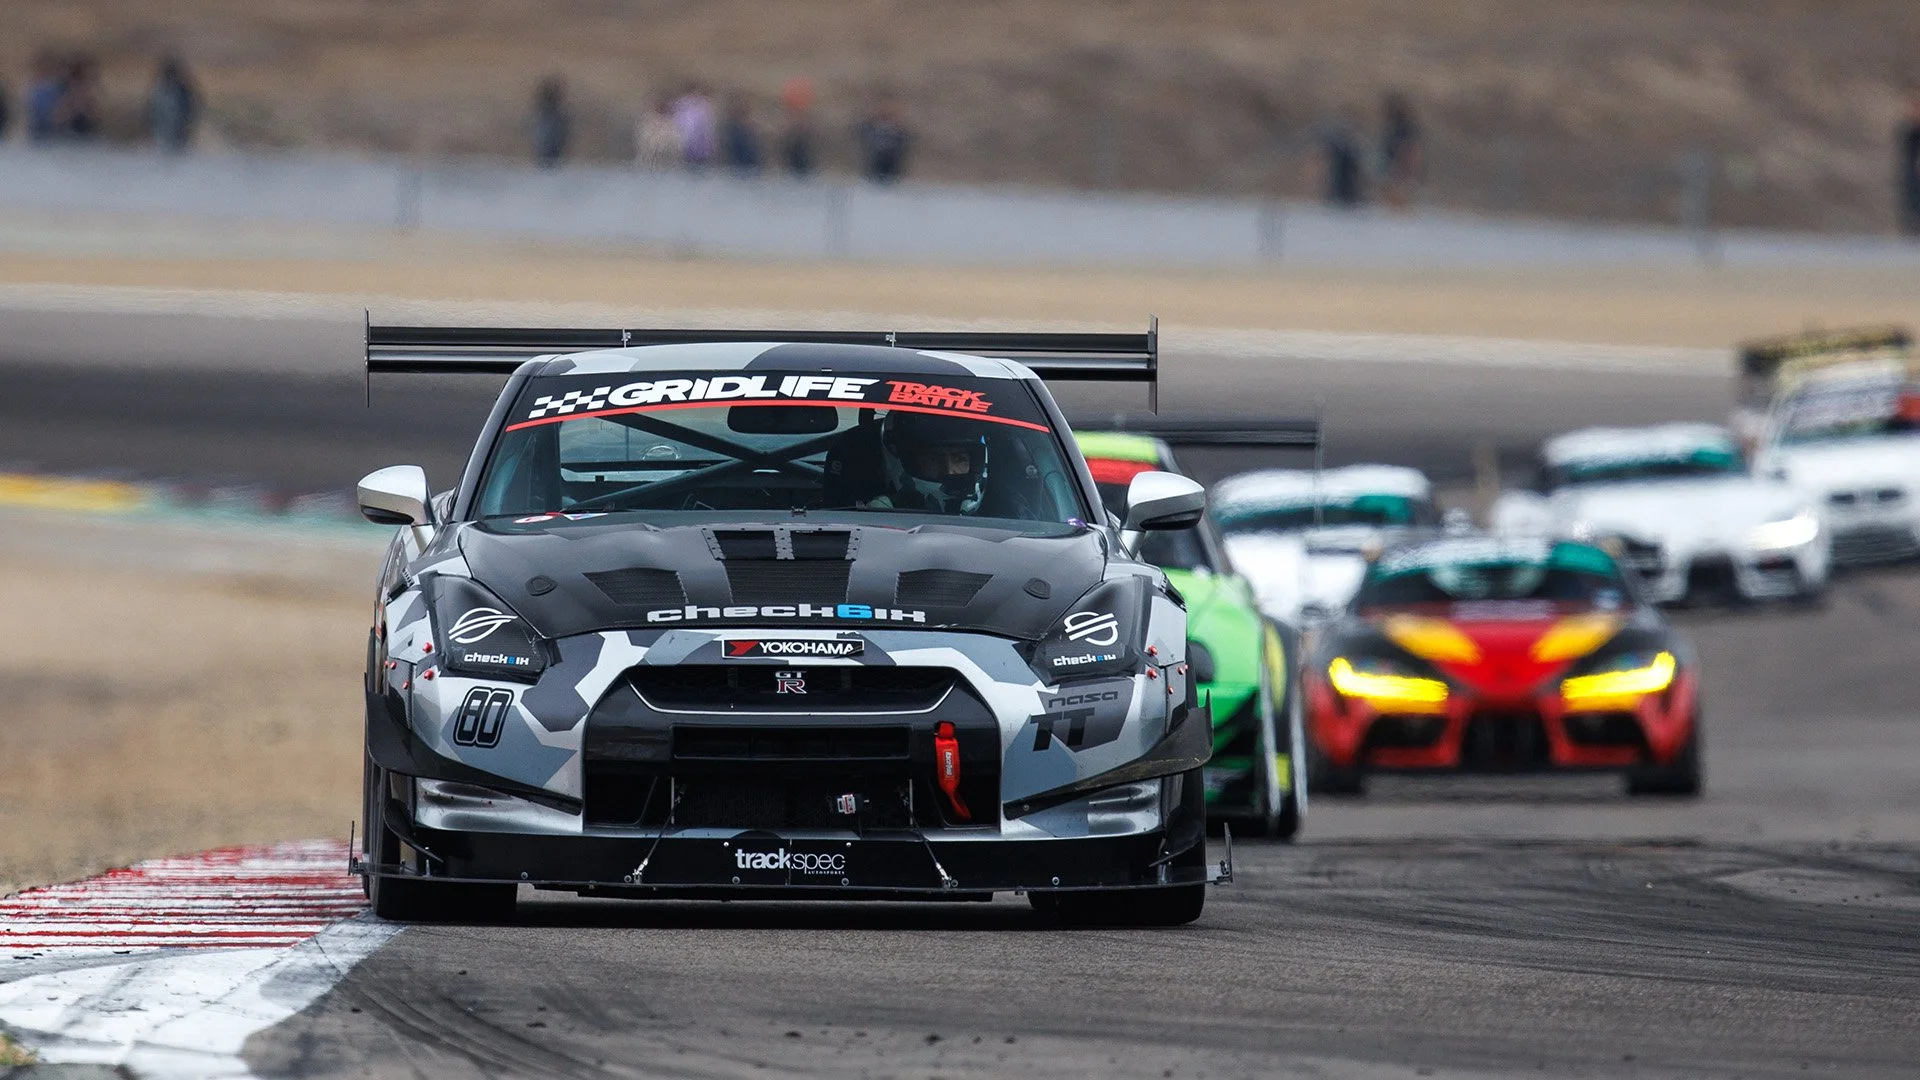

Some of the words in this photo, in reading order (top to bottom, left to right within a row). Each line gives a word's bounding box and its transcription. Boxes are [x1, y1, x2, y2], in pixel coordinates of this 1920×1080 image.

[608, 375, 879, 406] GRIDLIFE
[885, 381, 986, 400] TRACK
[888, 392, 993, 412] BATTLE
[759, 641, 854, 655] YOKOHAMA
[776, 679, 807, 694] R
[1048, 691, 1118, 708] nasa
[453, 686, 514, 749] 80
[1030, 707, 1095, 752] TT
